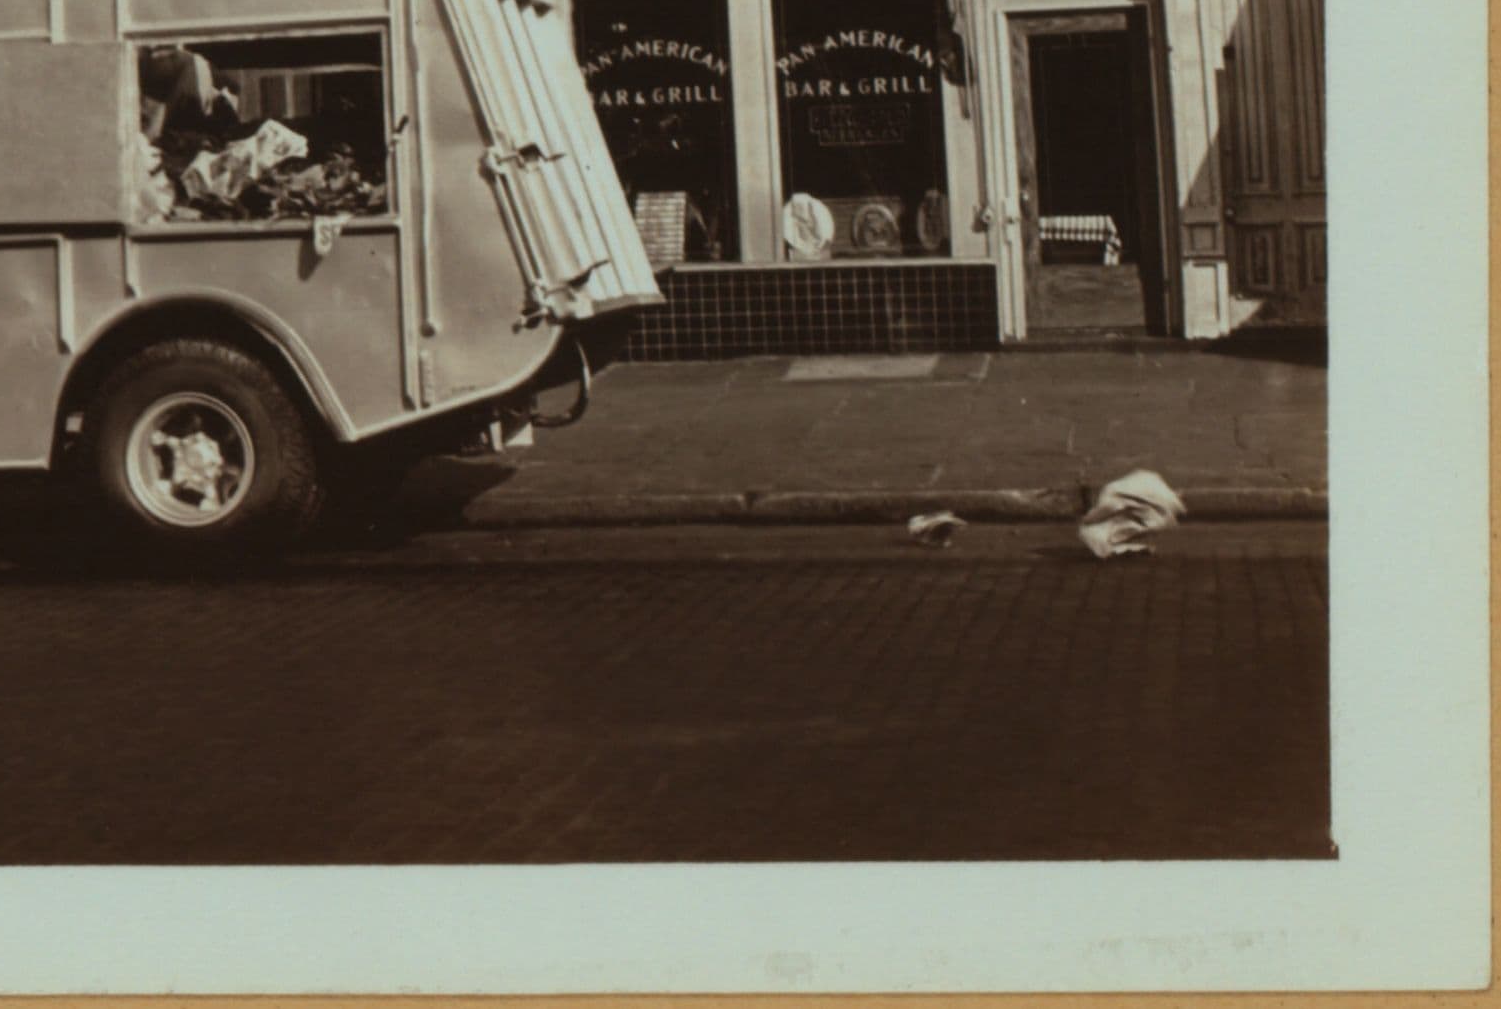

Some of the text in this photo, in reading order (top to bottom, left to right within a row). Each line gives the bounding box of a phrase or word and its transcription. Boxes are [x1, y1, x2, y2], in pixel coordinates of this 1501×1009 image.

[652, 85, 723, 104] GRILL
[785, 79, 831, 98] BAR
[858, 76, 932, 95] GRILL
